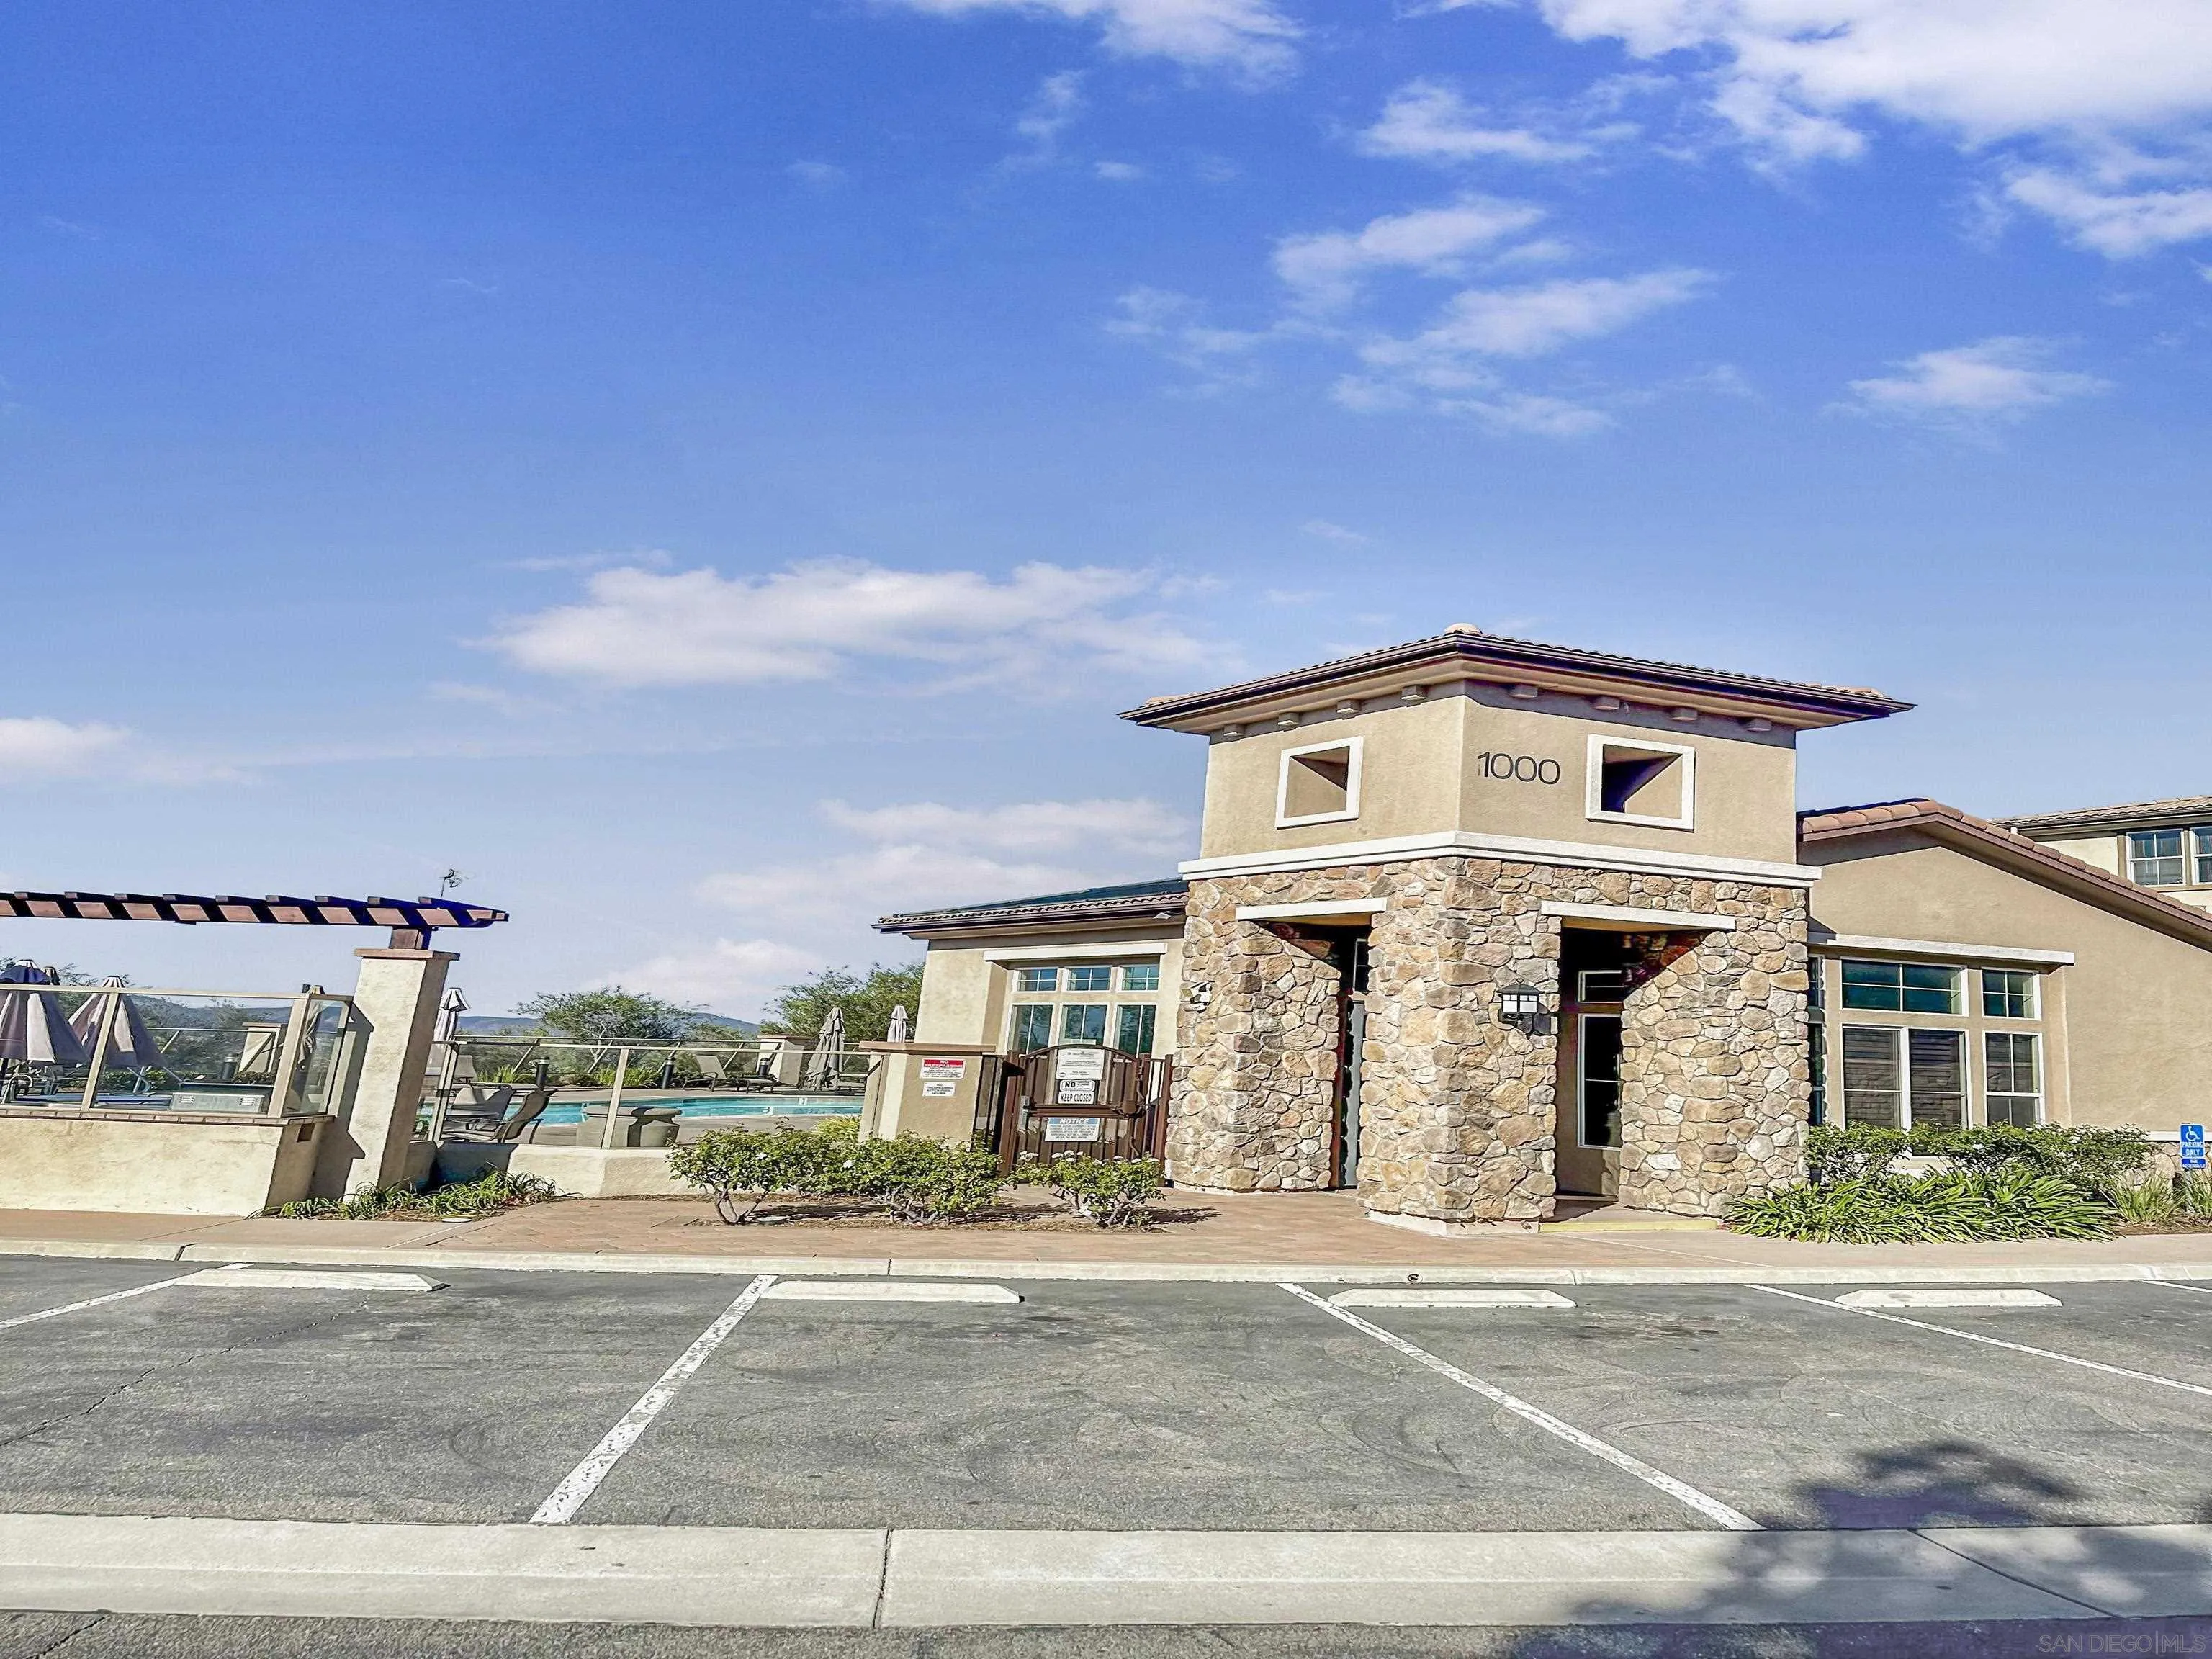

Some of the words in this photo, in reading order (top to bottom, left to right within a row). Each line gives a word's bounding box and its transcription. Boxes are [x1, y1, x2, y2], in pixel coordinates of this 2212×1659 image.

[1478, 752, 1560, 785] 1000
[1061, 1093, 1073, 1102] KEEP
[1074, 1093, 1092, 1102] CLOSED
